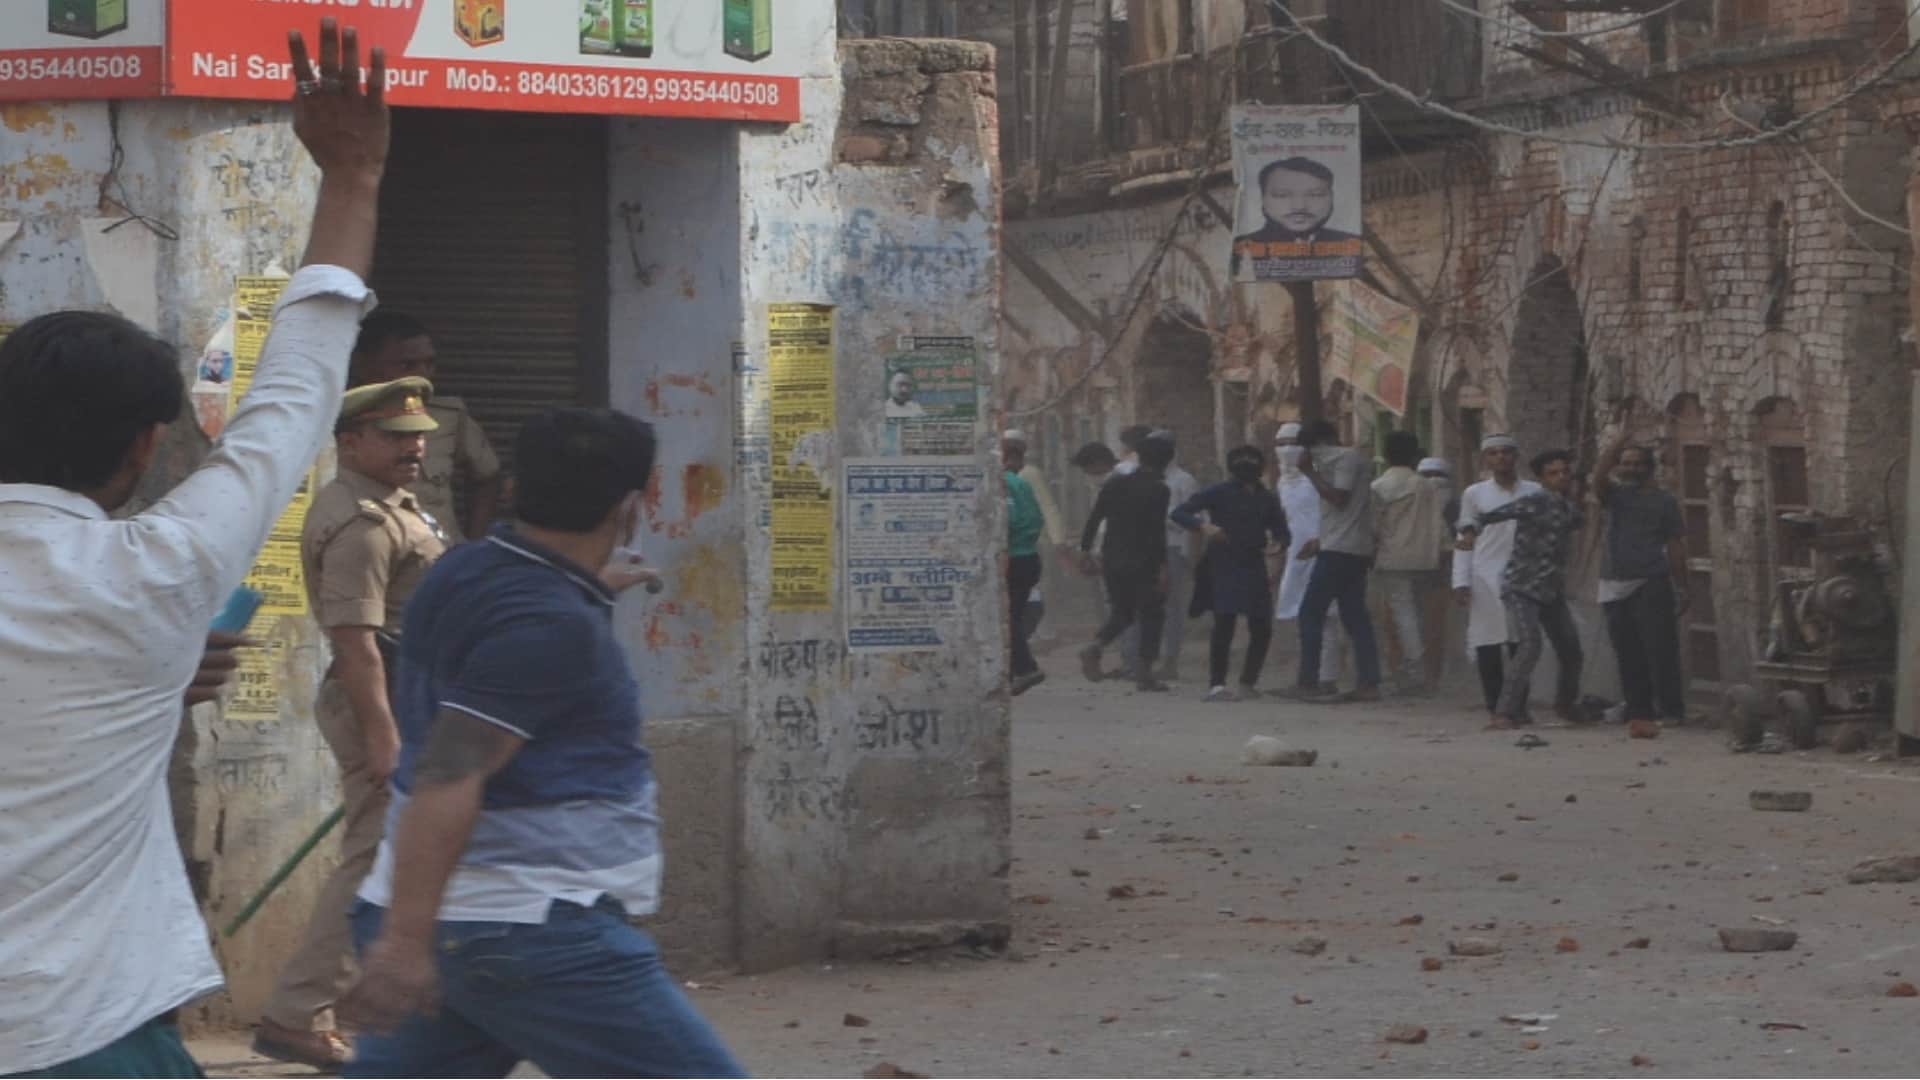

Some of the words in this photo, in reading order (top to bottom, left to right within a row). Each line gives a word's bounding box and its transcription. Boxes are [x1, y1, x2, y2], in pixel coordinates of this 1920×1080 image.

[0, 55, 142, 81] 935440508
[192, 52, 238, 78] Nai
[446, 67, 511, 94] Mob.:
[517, 70, 779, 106] 8840336129,9935440508
